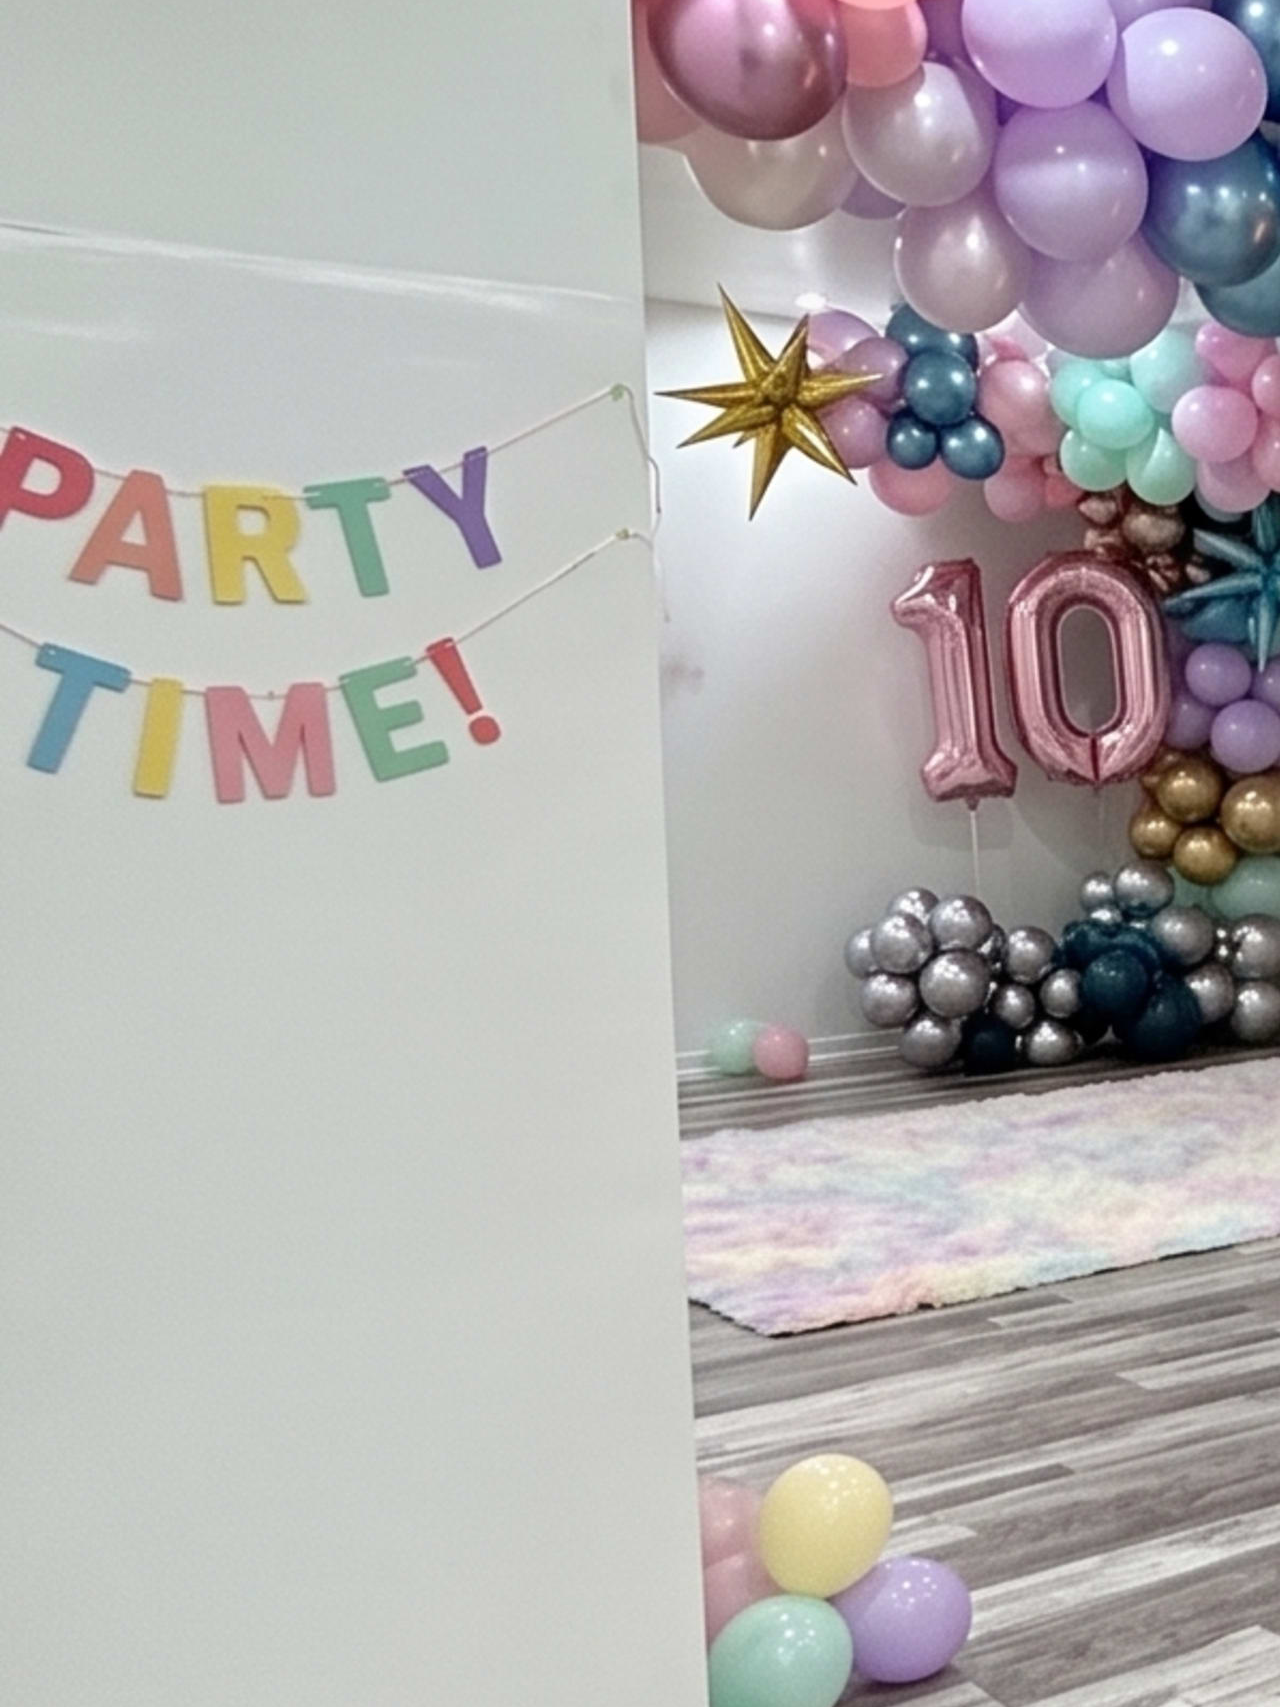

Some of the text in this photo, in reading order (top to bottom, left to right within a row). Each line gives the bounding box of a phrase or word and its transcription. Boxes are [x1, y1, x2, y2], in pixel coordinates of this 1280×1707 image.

[0, 426, 501, 605] PARTY
[27, 637, 501, 804] TIME!
[891, 550, 1172, 809] 10
